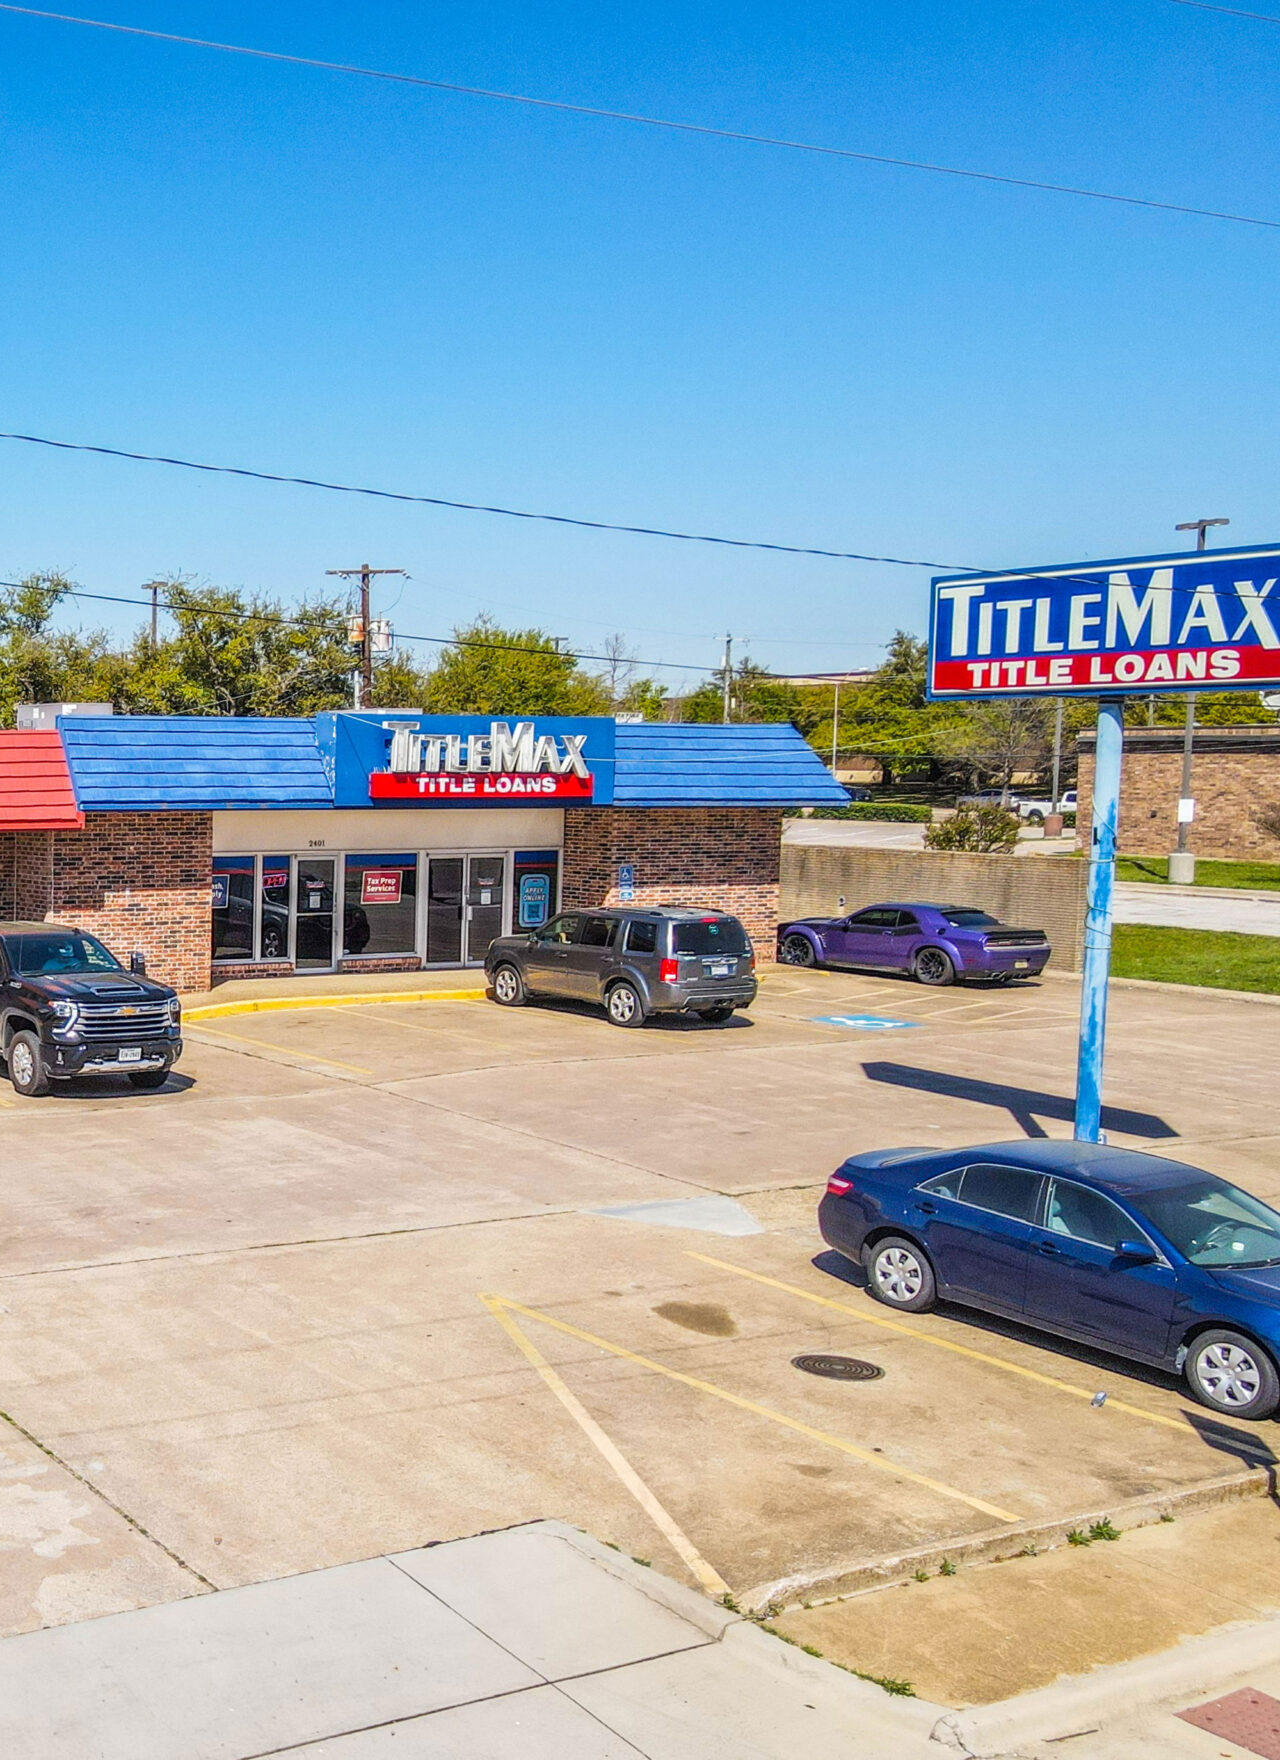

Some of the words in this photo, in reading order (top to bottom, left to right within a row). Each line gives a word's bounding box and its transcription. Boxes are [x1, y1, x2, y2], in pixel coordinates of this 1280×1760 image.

[967, 658, 1073, 687] TITLE
[1090, 650, 1240, 683] LOANS
[416, 777, 475, 793] TITLE
[483, 777, 556, 793] LOANS
[380, 877, 396, 885] Prep
